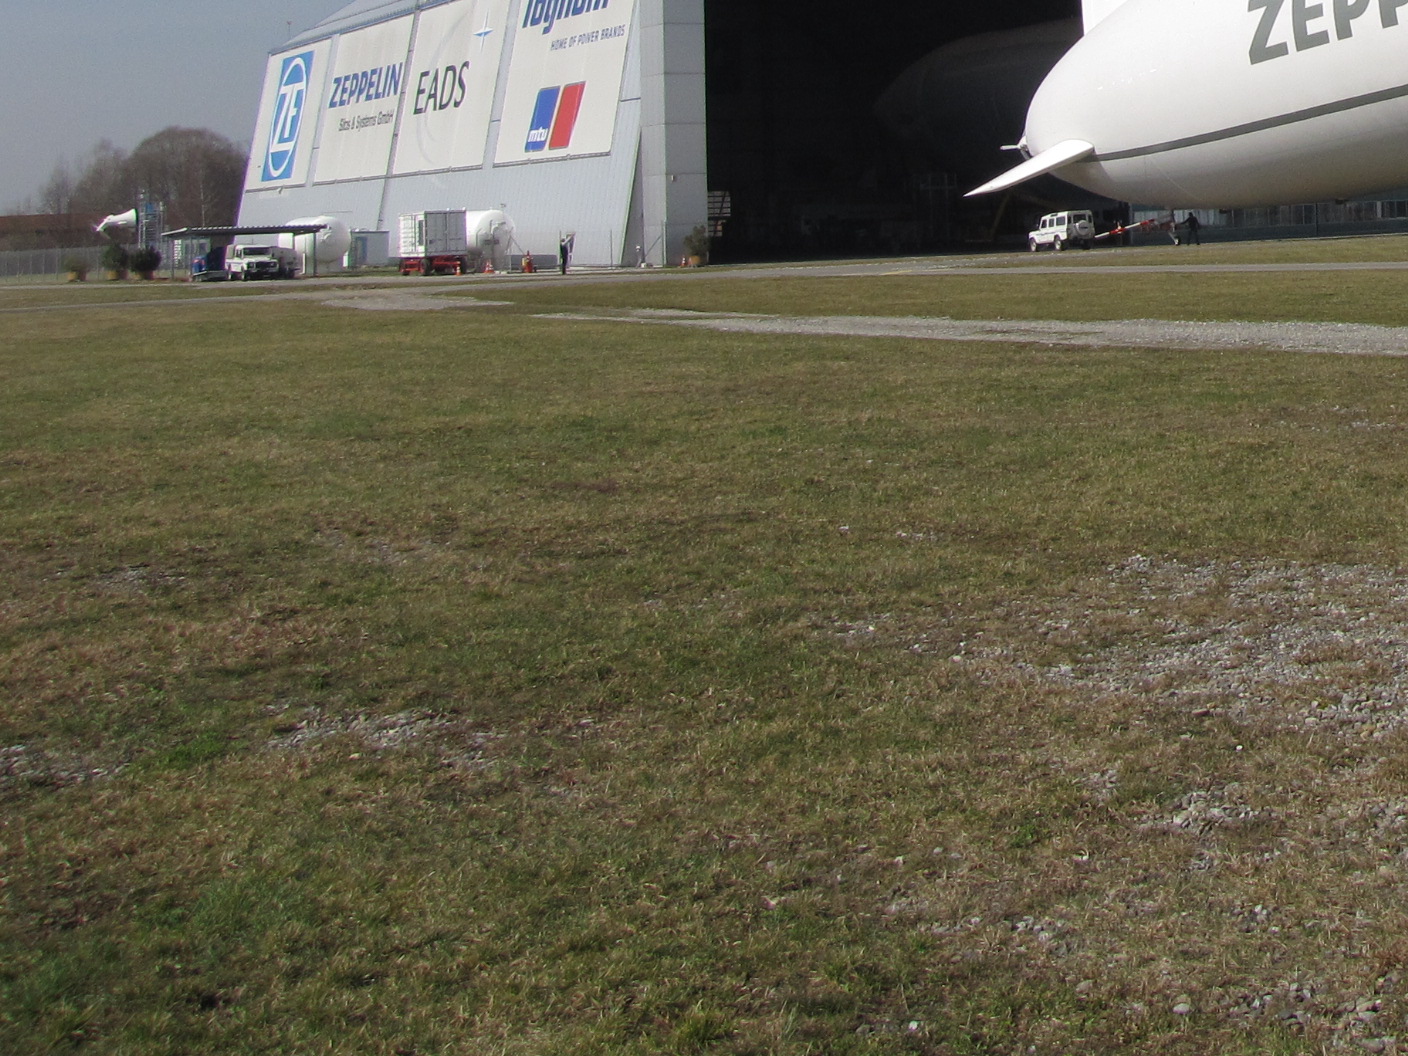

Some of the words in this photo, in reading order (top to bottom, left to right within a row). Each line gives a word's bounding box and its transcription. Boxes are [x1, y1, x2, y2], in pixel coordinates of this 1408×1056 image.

[550, 38, 568, 51] HOME
[568, 35, 578, 48] OF
[577, 30, 600, 46] POWER
[600, 24, 626, 41] BRANDS
[328, 62, 404, 109] ZEPPELIN
[413, 60, 470, 115] EADS
[377, 109, 395, 125] GmbH
[528, 126, 549, 143] mtu
